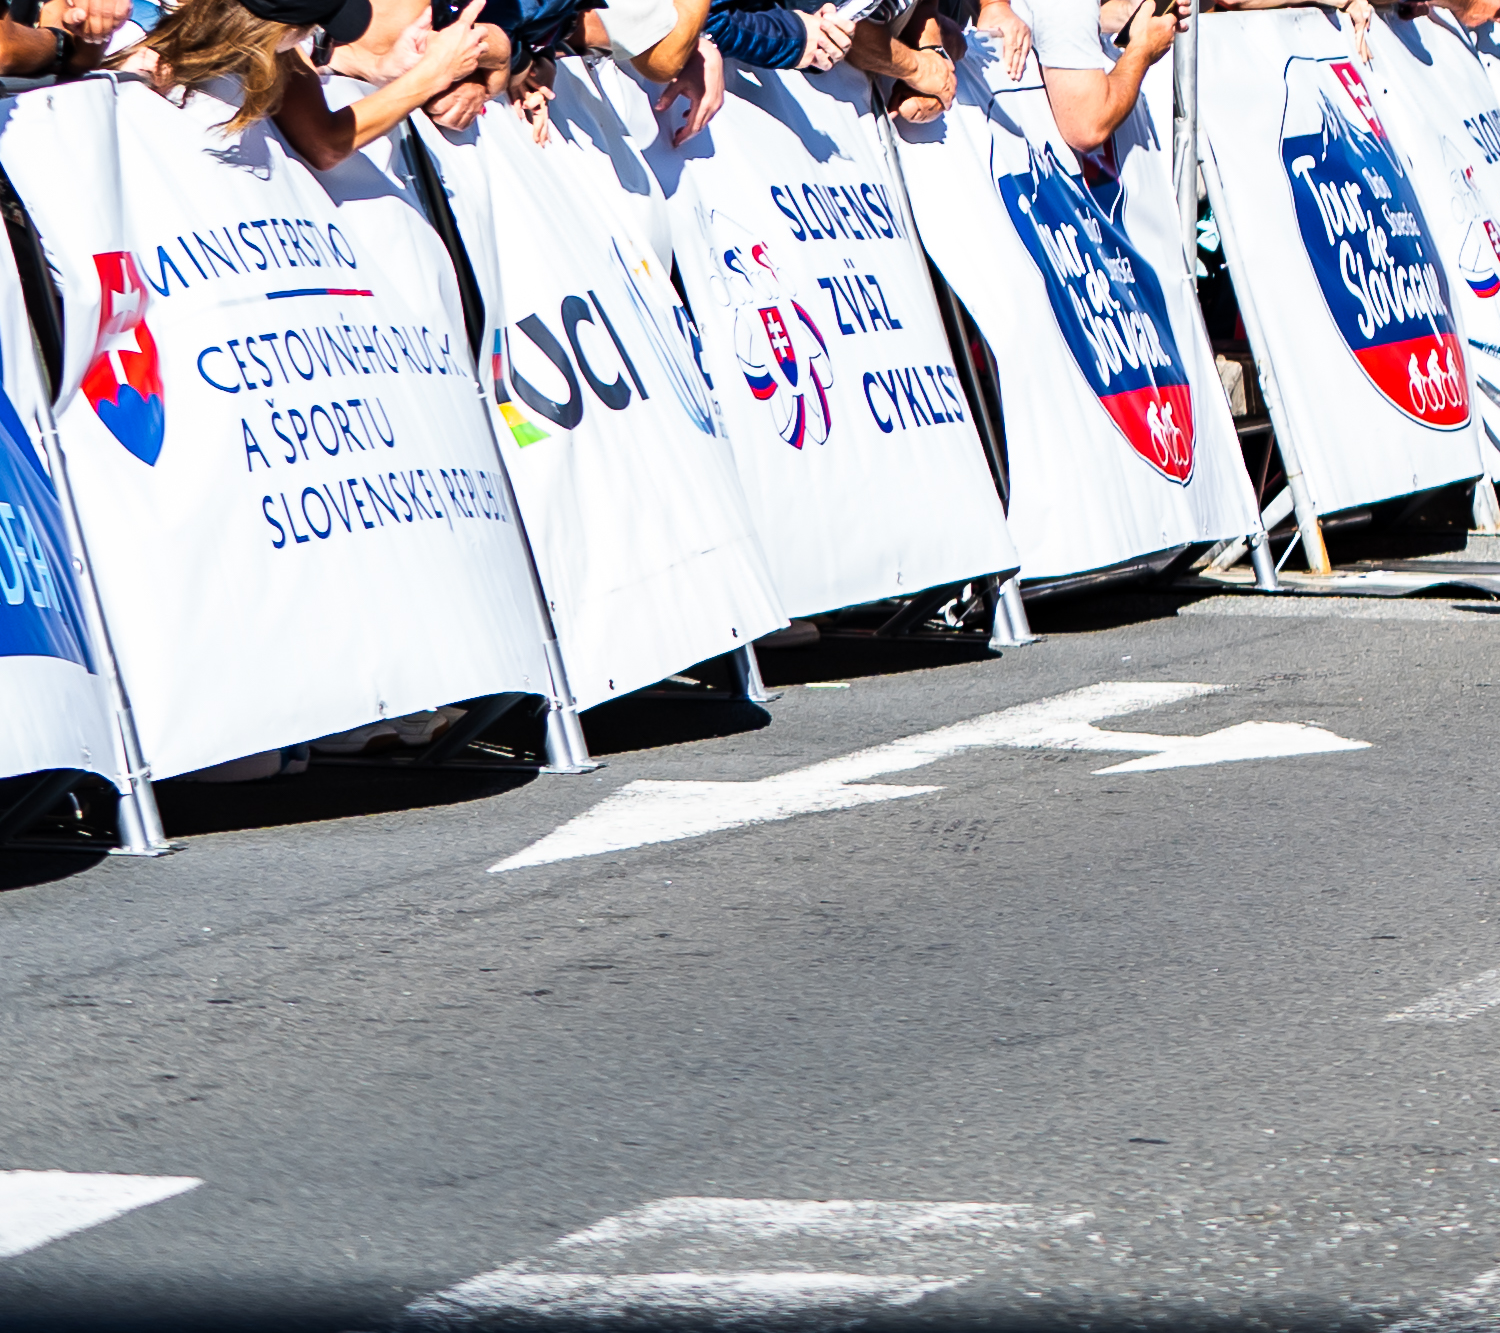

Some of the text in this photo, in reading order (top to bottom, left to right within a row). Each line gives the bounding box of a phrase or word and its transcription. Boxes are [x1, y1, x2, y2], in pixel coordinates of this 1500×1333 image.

[770, 182, 907, 241] SLOVENSK
[1291, 154, 1368, 247] Tour
[138, 217, 358, 297] MINISTERSTVO
[1366, 209, 1395, 273] de
[816, 258, 903, 336] ZVÄZ
[196, 312, 399, 393] CESTOVNÉHO
[511, 290, 648, 431] UCI
[241, 397, 395, 472] A ŠPORTU
[262, 468, 454, 549] SLOVENSKEJ
[0, 501, 62, 612] DEA
